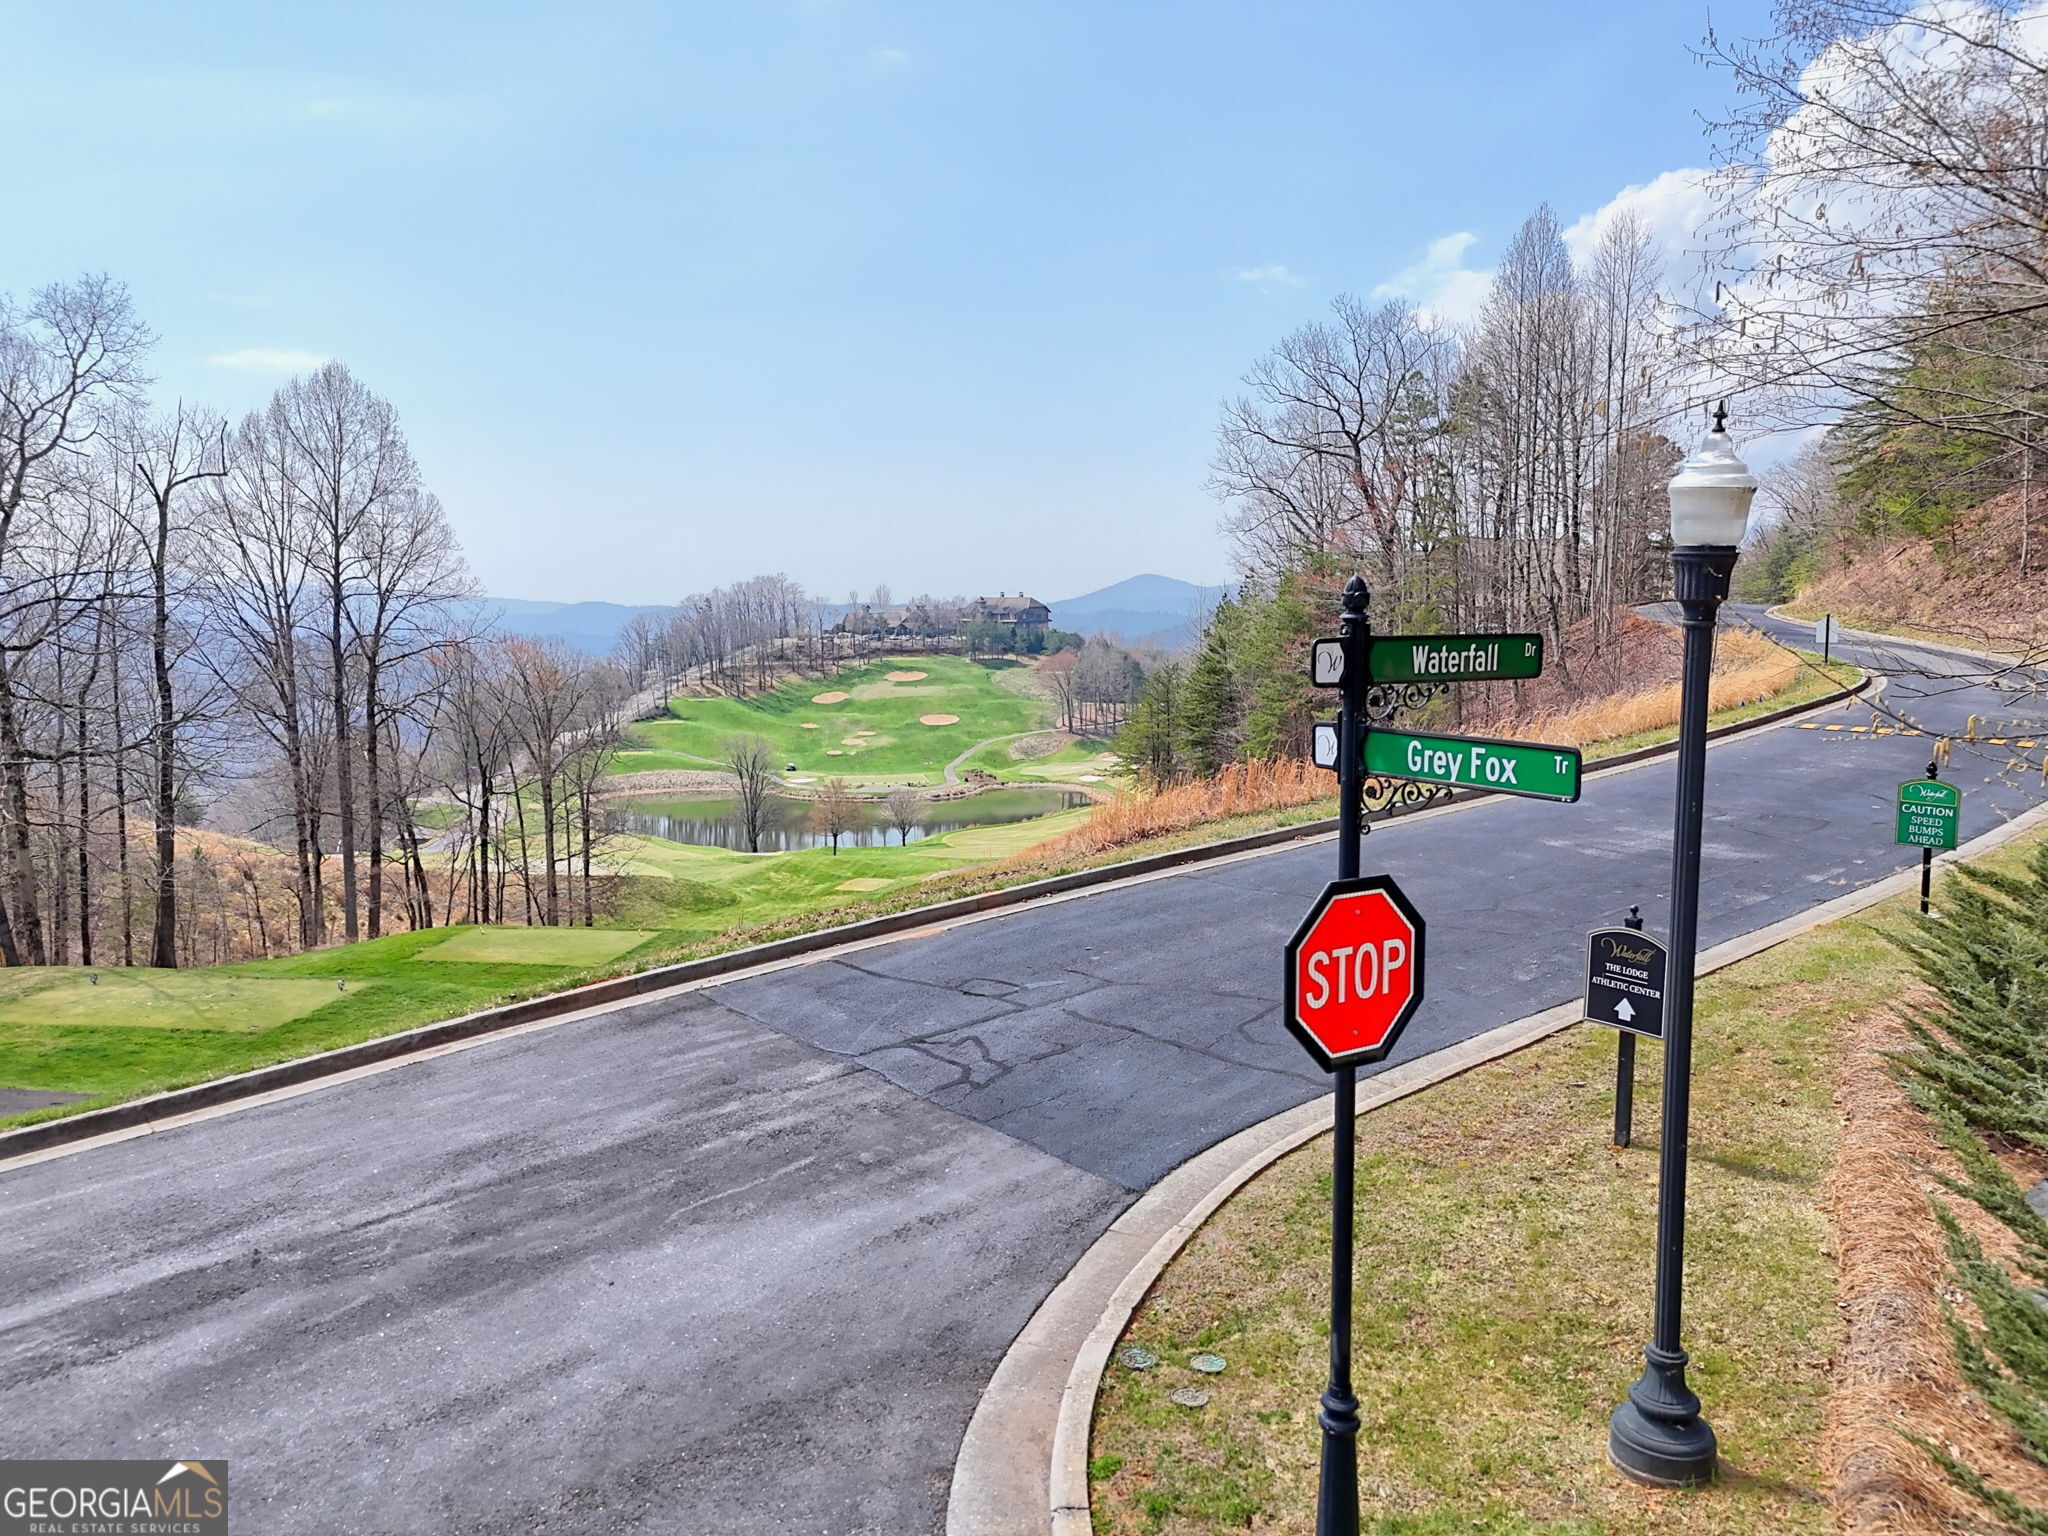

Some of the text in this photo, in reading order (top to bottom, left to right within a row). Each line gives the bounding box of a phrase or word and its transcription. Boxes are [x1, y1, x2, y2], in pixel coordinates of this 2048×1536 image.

[1412, 642, 1537, 674] Waterfall Dr
[1407, 740, 1569, 784] Grey Fox Tr
[1901, 803, 1953, 817] CAUTION
[1908, 825, 1944, 836] BUMPS
[1911, 816, 1942, 826] SPEED
[1908, 835, 1943, 845] AHEAD
[1600, 937, 1656, 963] Waterfall
[1305, 938, 1406, 1010] STOP
[1605, 962, 1621, 973] THE
[1622, 966, 1648, 979] LODGE
[1591, 976, 1661, 999] ATHLETIC CENTER
